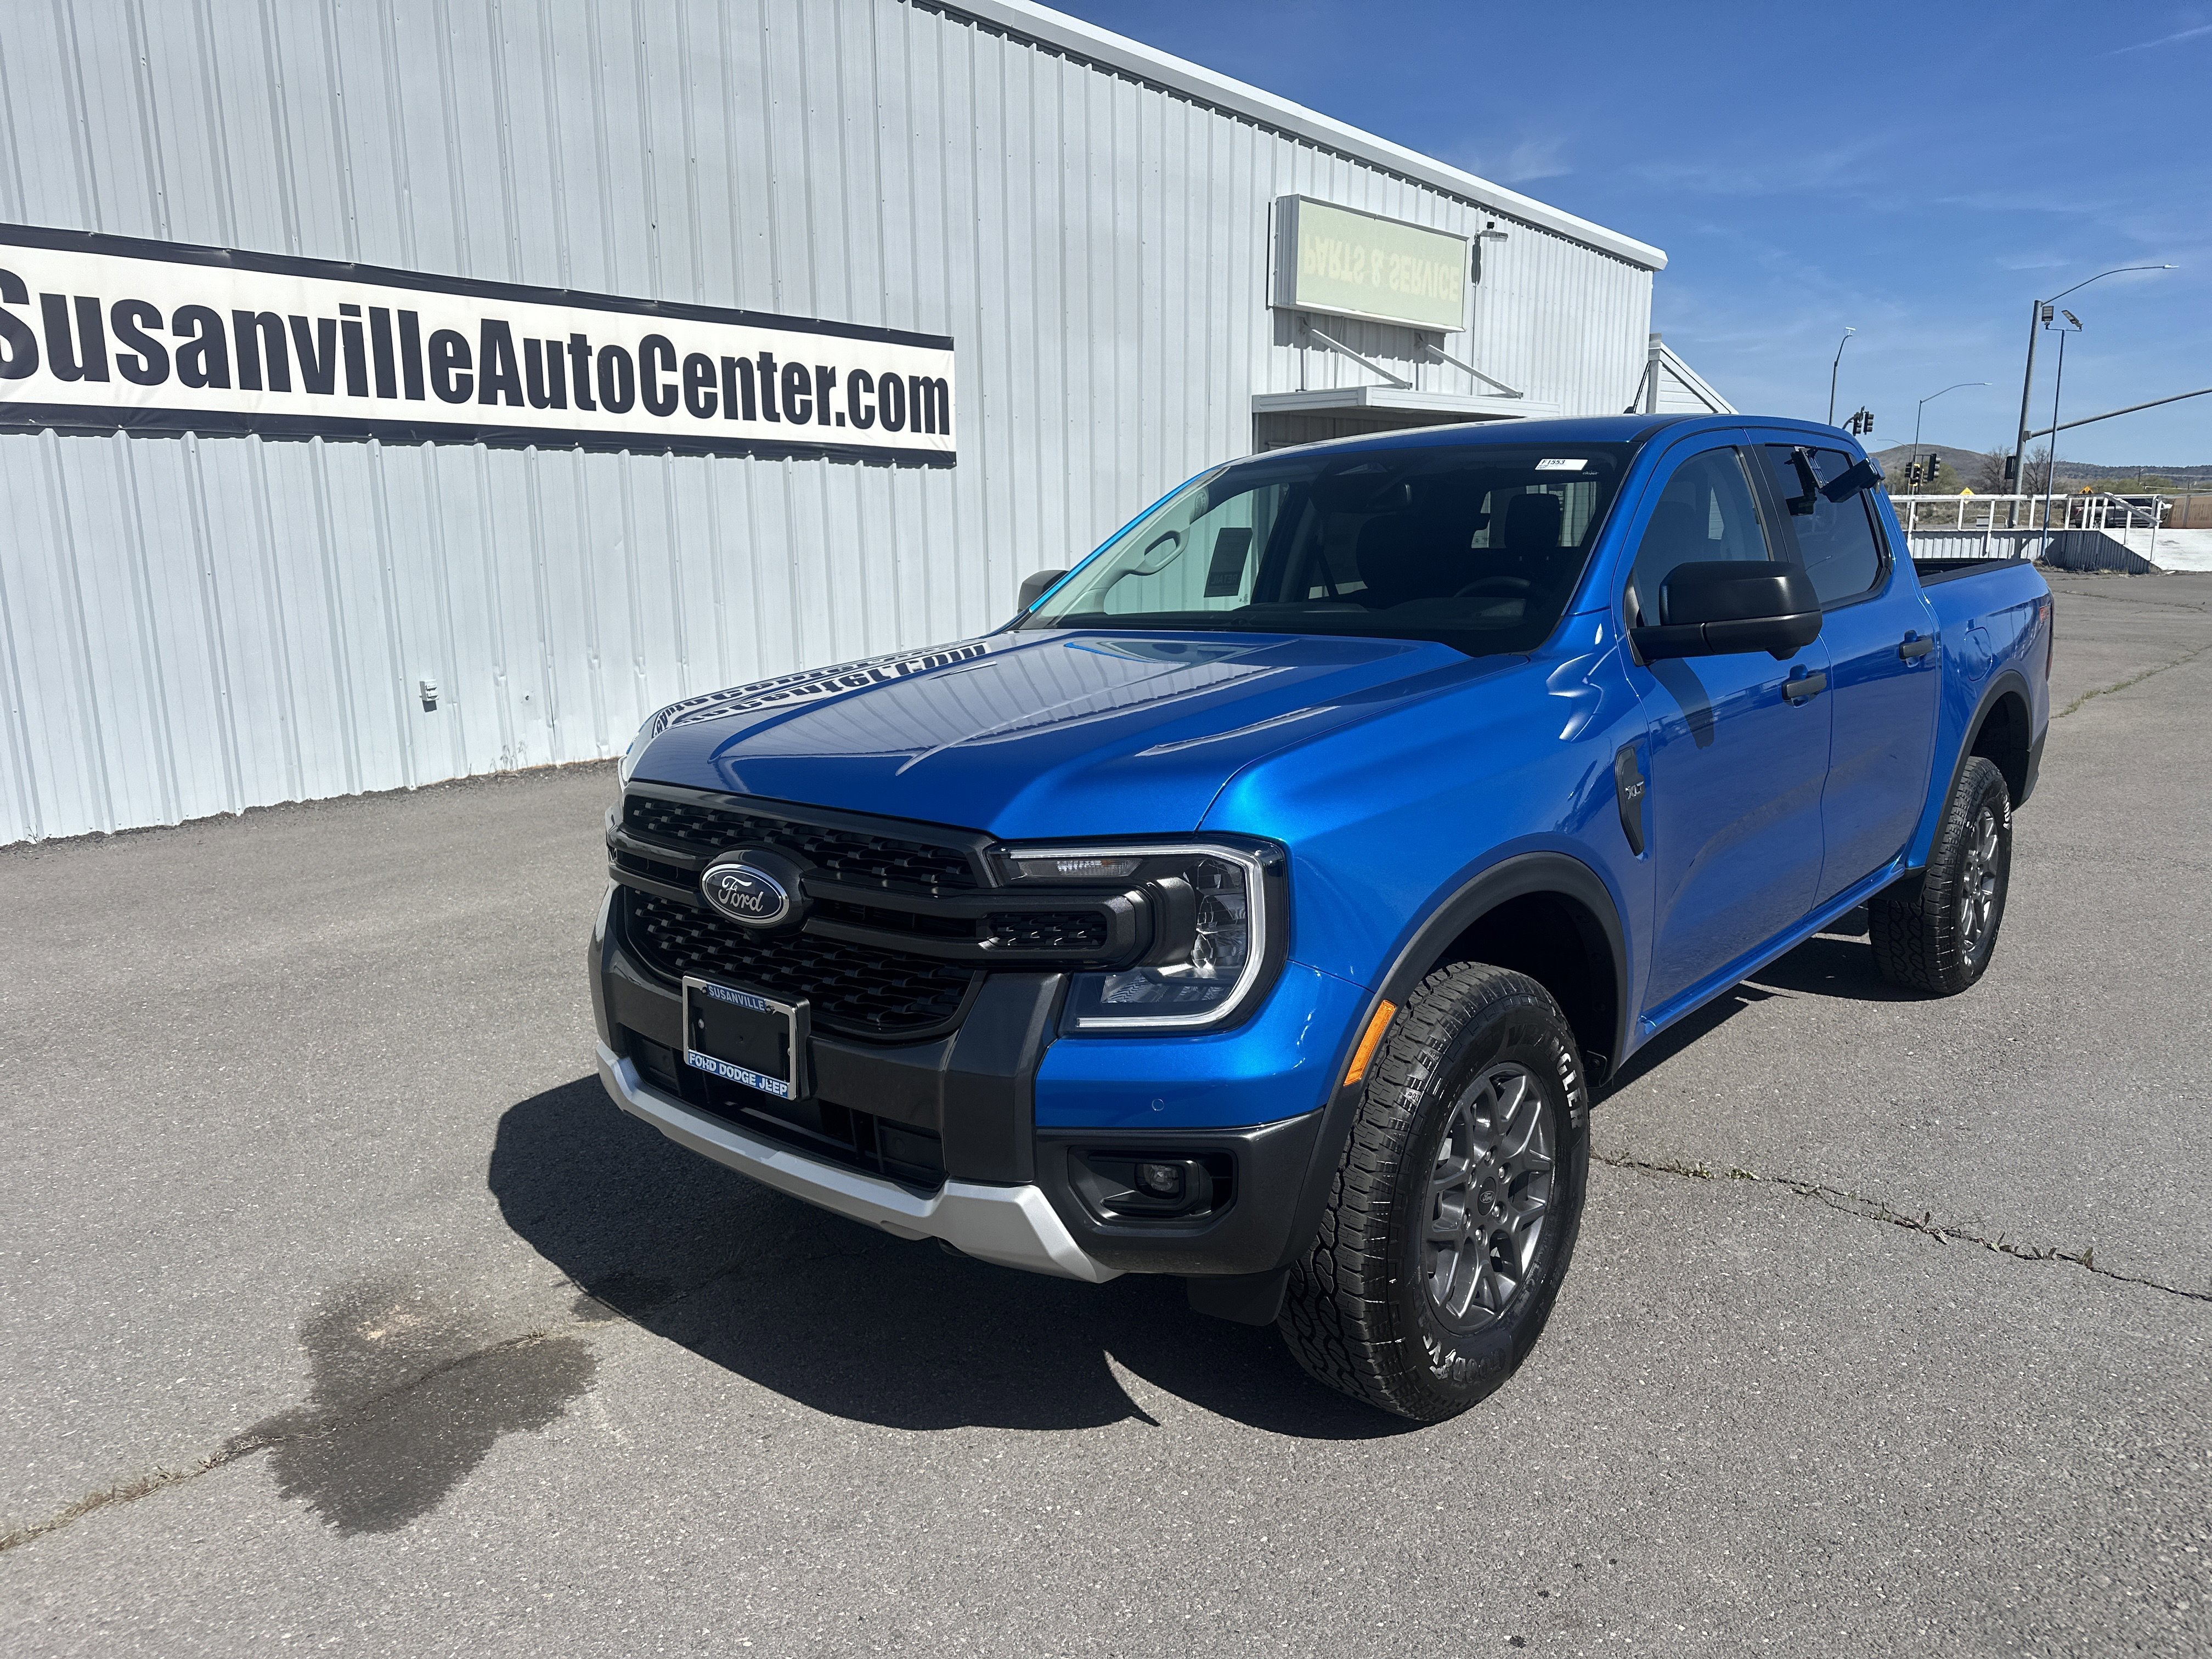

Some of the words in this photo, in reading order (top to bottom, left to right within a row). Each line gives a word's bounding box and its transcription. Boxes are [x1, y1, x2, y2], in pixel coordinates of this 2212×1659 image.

[0, 268, 950, 435] SusanvilleAutoCenter.com
[718, 875, 764, 913] Ford
[708, 986, 765, 1011] SUSANVILLE
[689, 1053, 716, 1071] FORD
[719, 1063, 756, 1086] DODGE
[759, 1077, 787, 1096] JEEP
